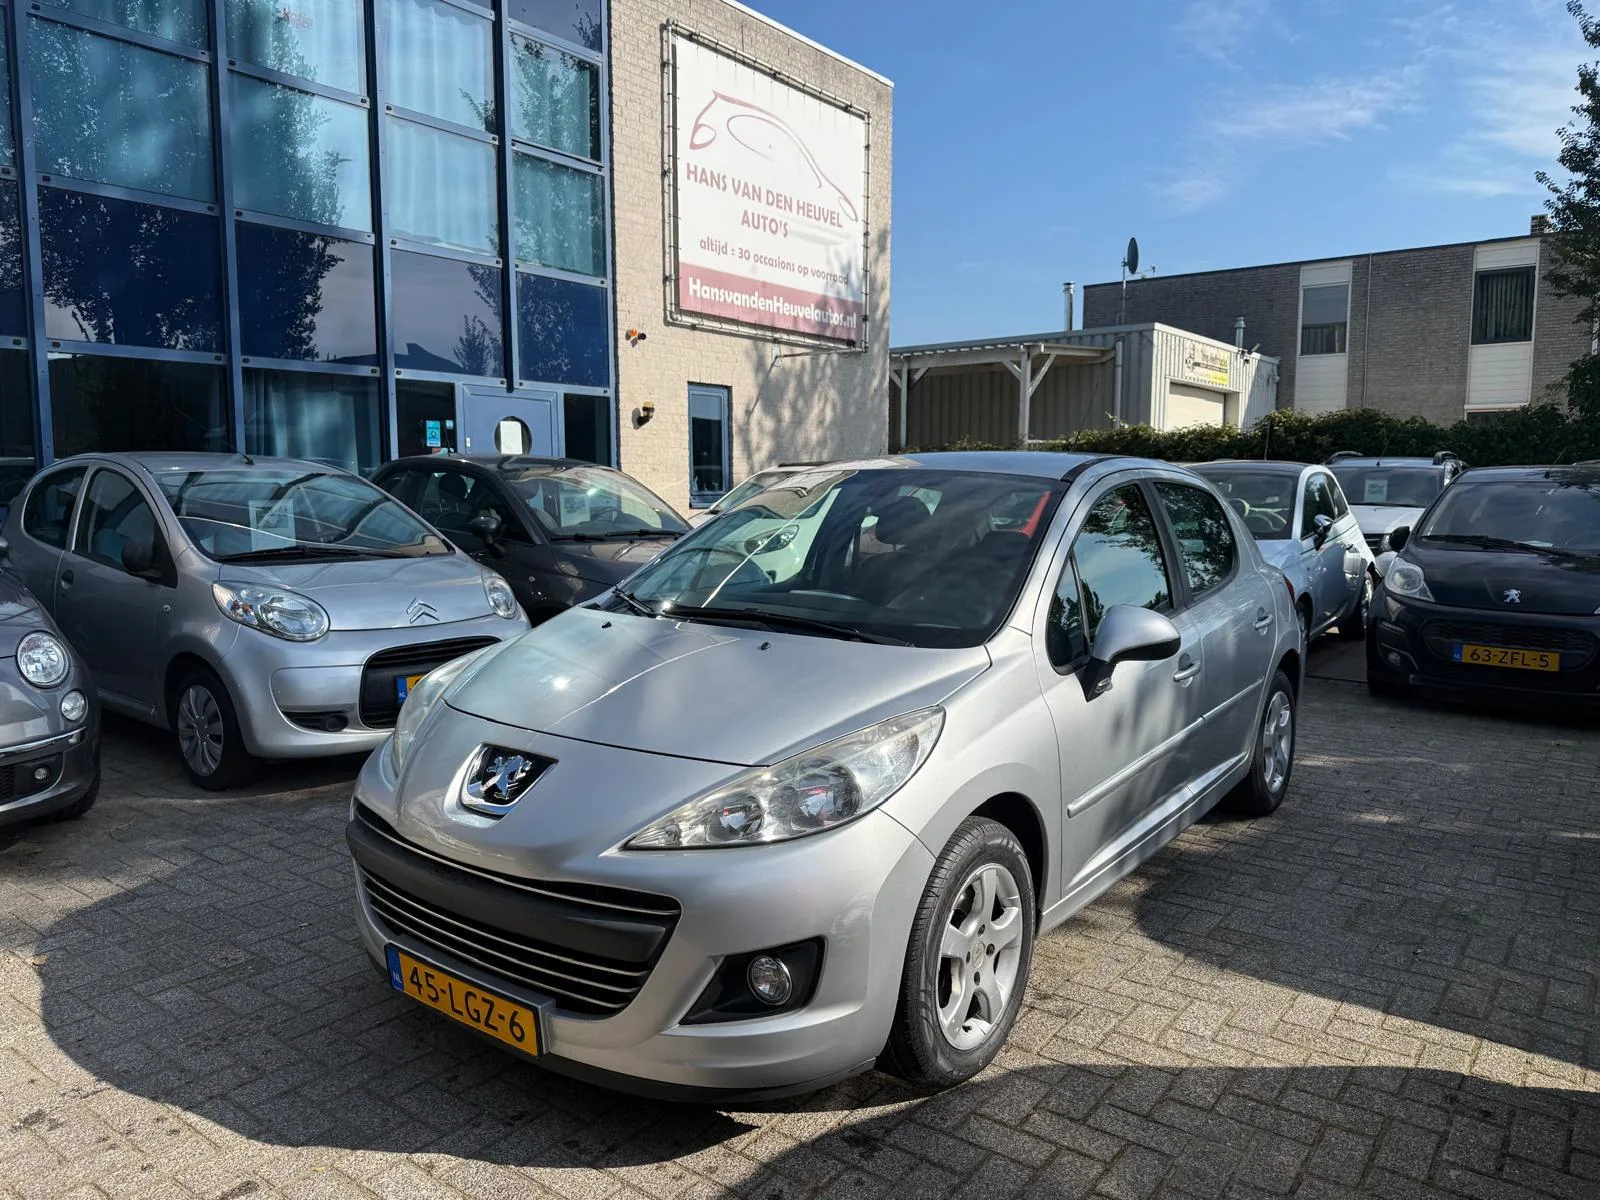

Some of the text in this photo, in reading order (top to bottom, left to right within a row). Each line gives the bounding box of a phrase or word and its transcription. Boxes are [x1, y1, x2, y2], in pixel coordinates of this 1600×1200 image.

[686, 162, 843, 228] HANS VAN DEN HEUVEL
[741, 210, 788, 238] AUTO'S
[699, 236, 728, 256] altijd
[738, 247, 751, 261] 30
[753, 254, 795, 272] occasions
[797, 264, 809, 277] op
[811, 268, 849, 285] voorraad
[688, 277, 857, 329] HansvandenHeuvelautos.nl
[1470, 648, 1550, 668] 63-ZFL-5
[392, 971, 402, 984] NL
[409, 966, 526, 1043] 45-LGZ-6
